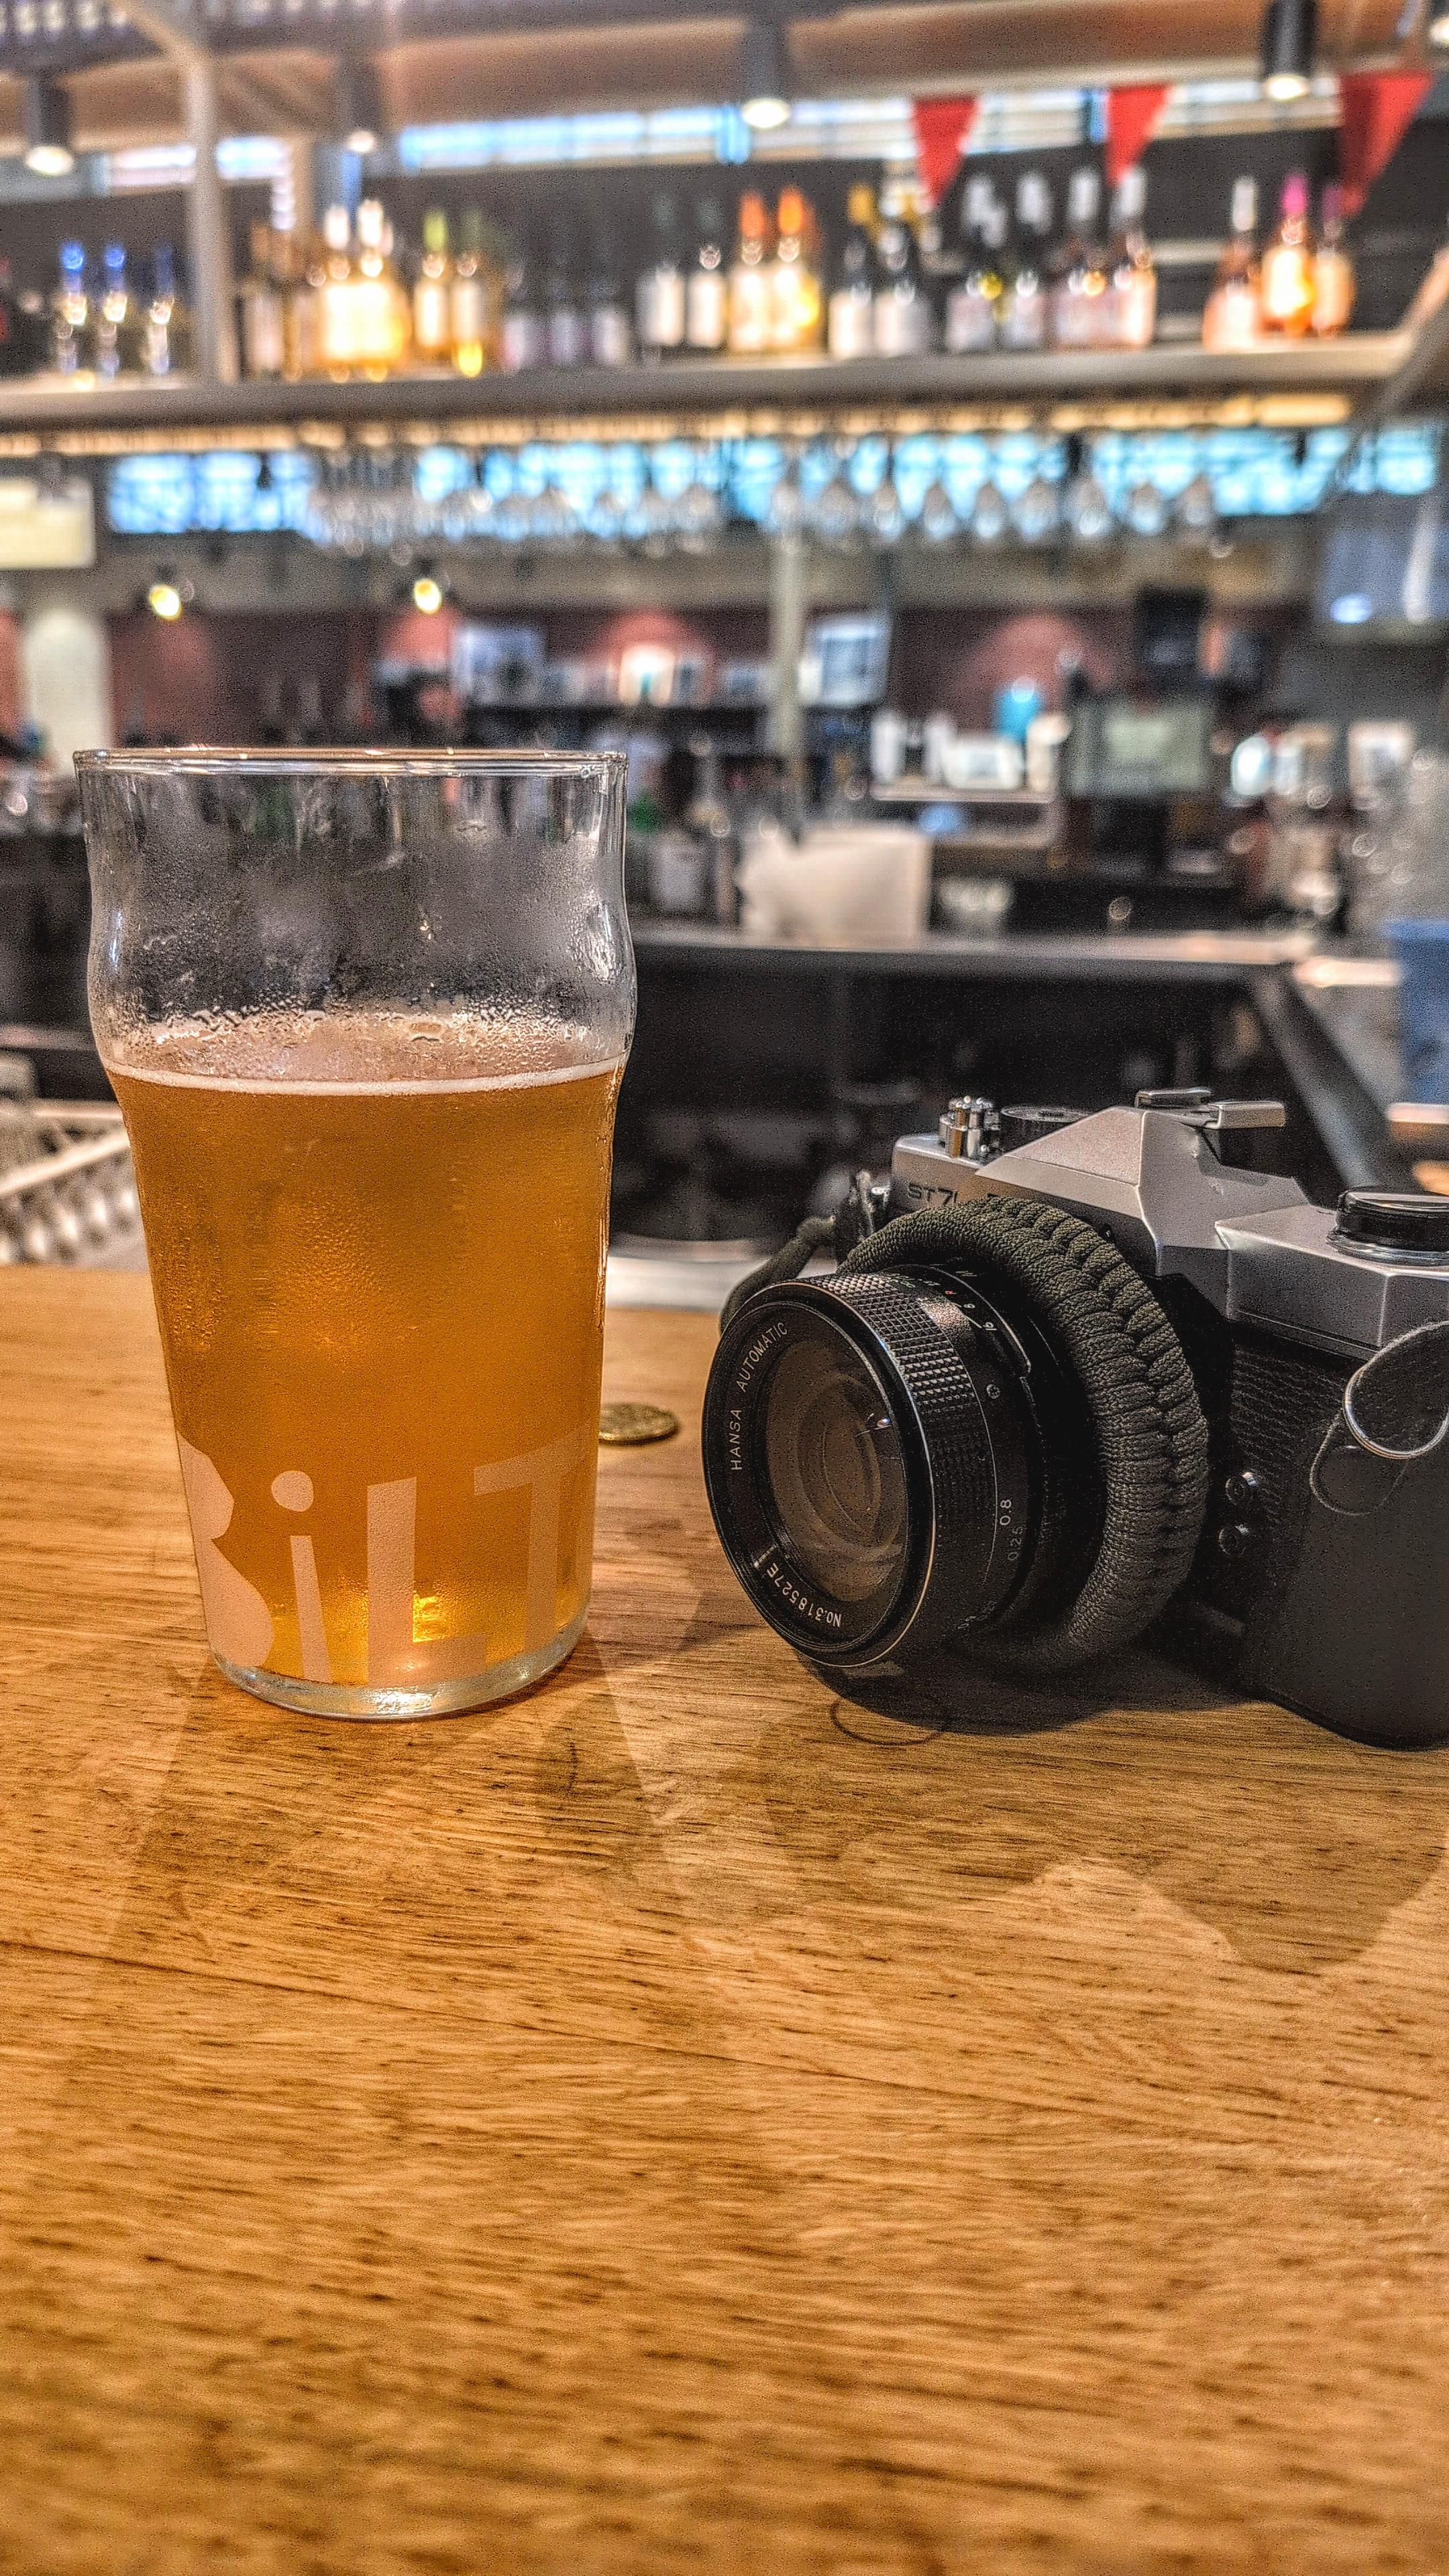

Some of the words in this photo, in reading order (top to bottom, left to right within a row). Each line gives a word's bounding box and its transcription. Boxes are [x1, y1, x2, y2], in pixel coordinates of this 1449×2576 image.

[729, 1409, 743, 1470] HANSA
[736, 1322, 788, 1393] AUTOMATIC
[1000, 1499, 1012, 1525] 0.8
